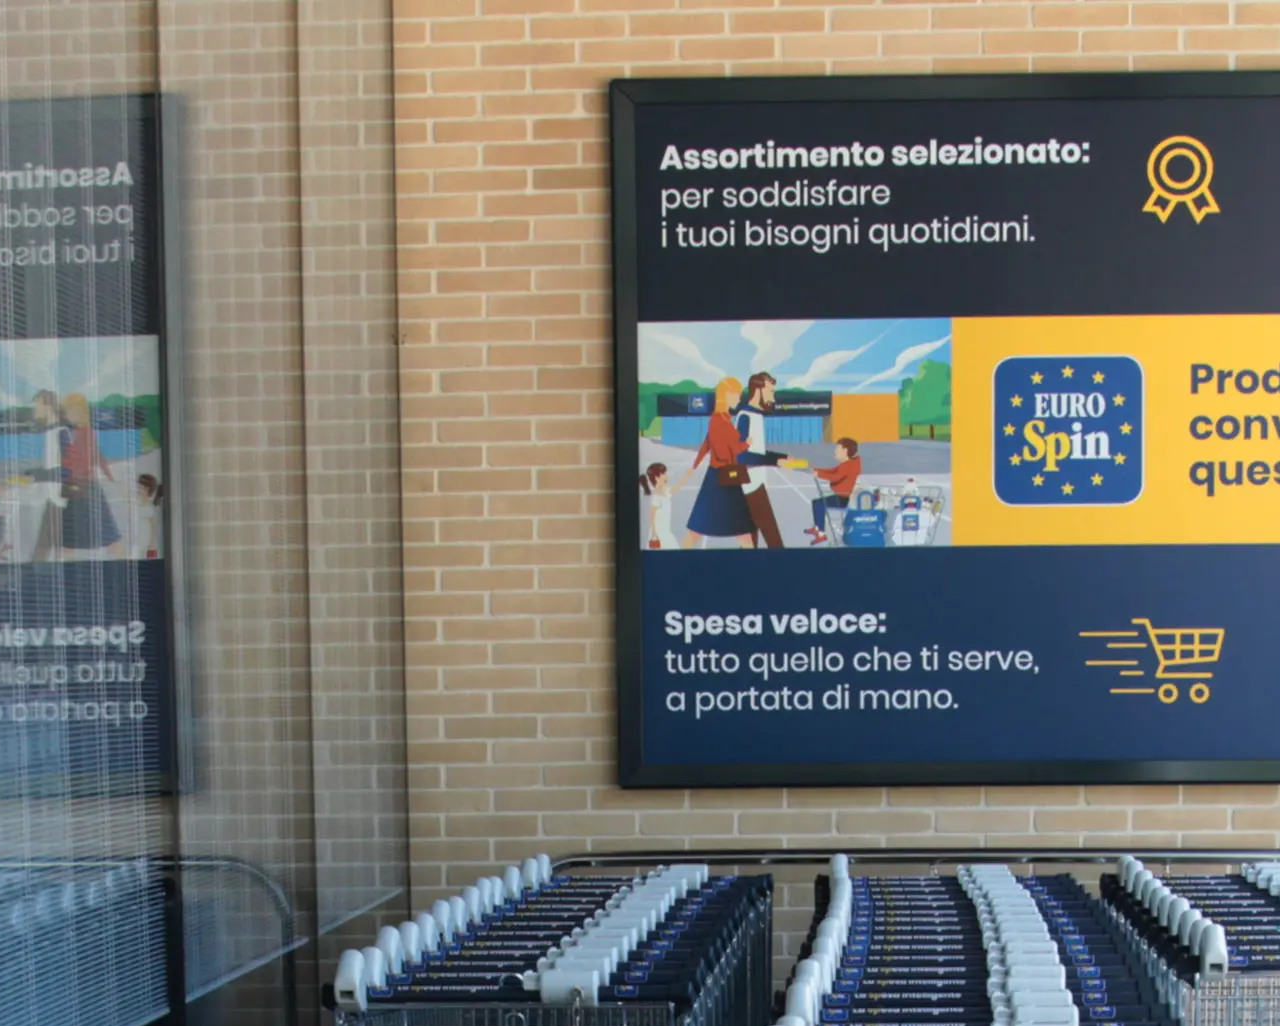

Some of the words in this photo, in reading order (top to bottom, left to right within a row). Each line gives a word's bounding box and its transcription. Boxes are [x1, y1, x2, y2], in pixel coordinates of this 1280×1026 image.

[659, 139, 885, 171] Assortimento
[891, 136, 1090, 166] selezionato:
[661, 187, 715, 218] per
[722, 179, 891, 208] soddisfare
[661, 220, 667, 248] i
[675, 219, 735, 248] tuoi
[745, 217, 859, 254] bisogni
[868, 214, 1036, 252] quotidiani.
[1033, 392, 1106, 419] EURO
[1022, 419, 1112, 473] Spin
[664, 610, 763, 644] Spesa
[769, 607, 887, 635] veloce:
[664, 649, 740, 674] tutto
[748, 646, 845, 681] quello
[852, 645, 912, 672] che
[919, 644, 939, 671] ti
[948, 650, 1040, 674] serve,
[665, 691, 686, 712] a
[695, 686, 813, 720] portata
[822, 683, 850, 710] di
[859, 689, 959, 710] mano.
